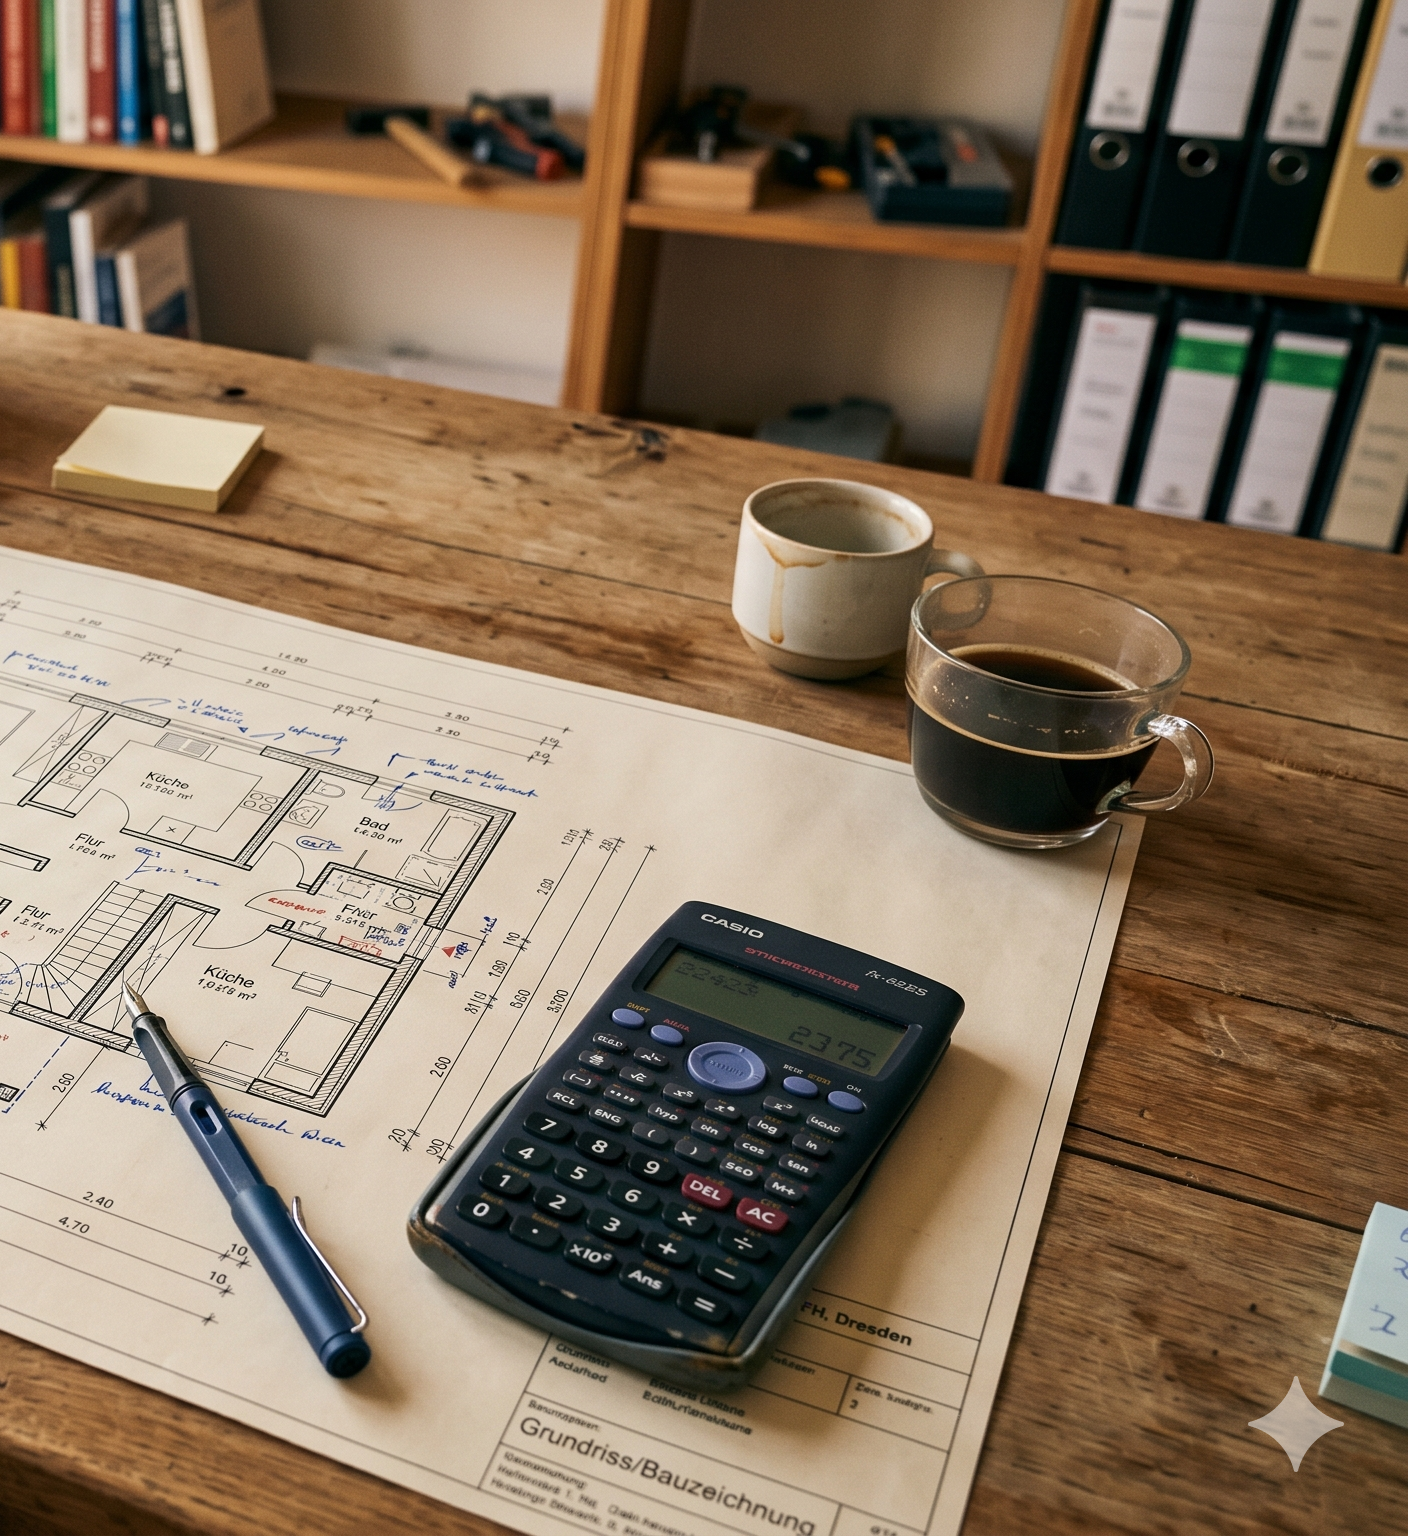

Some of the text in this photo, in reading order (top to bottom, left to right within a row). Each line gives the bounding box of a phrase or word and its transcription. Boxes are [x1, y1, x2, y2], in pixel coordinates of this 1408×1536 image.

[359, 816, 390, 831] Bad
[75, 832, 105, 847] Flur
[20, 904, 51, 920] Flur
[700, 913, 765, 940] CASIO
[203, 964, 255, 988] Küche
[788, 1025, 877, 1070] 2375
[540, 1118, 557, 1131] 7
[756, 1119, 778, 1135] log
[591, 1139, 608, 1153] 8
[518, 1147, 535, 1161] 4
[570, 1166, 588, 1180] 5
[643, 1160, 661, 1175] 9
[499, 1174, 511, 1187] 1
[624, 1189, 642, 1203] 6
[689, 1179, 721, 1201] DEL
[82, 1190, 115, 1210] 2.40
[548, 1194, 567, 1210] 2
[472, 1202, 490, 1217] 0
[746, 1207, 776, 1225] AC
[58, 1215, 91, 1235] 4.70
[602, 1217, 621, 1232] 3
[230, 1243, 248, 1257] 10
[209, 1270, 228, 1285] 10
[627, 1269, 663, 1290] Ans
[835, 1312, 912, 1346] Dresden
[520, 1415, 816, 1536] Grundriss/Bauzeichnung
